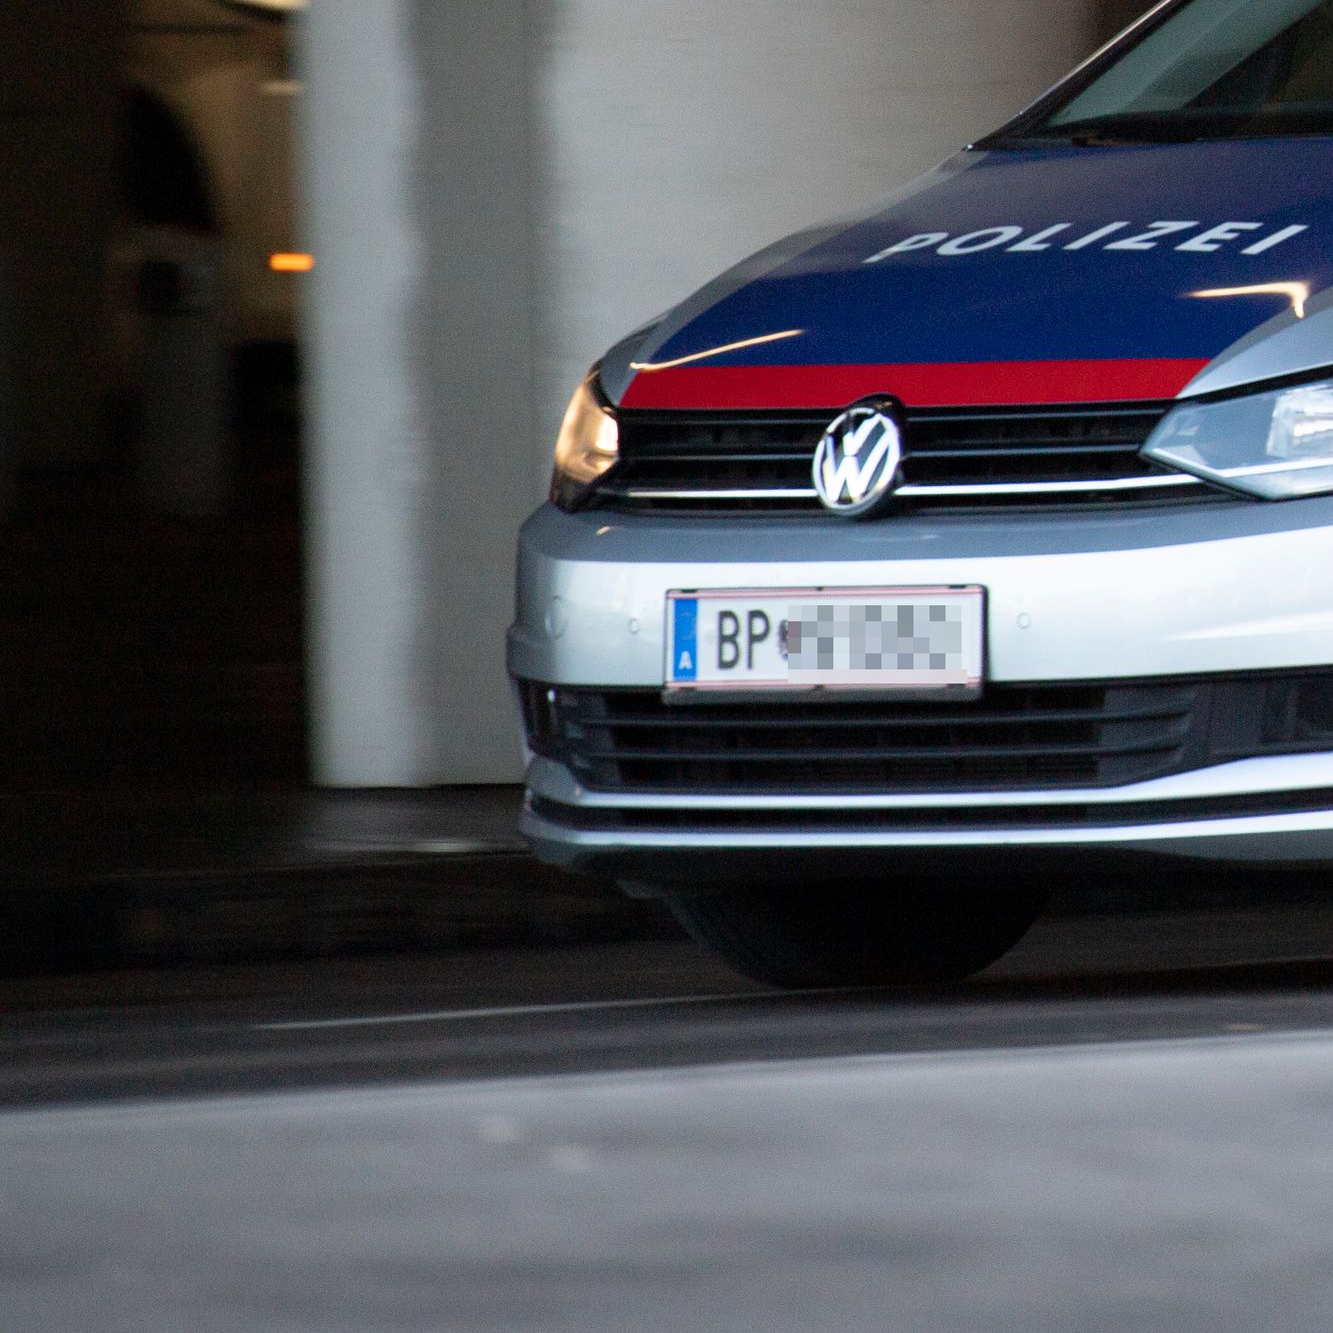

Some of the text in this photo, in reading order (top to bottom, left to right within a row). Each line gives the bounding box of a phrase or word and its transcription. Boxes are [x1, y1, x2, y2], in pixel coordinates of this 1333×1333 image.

[863, 219, 1308, 263] POLIZEI
[678, 651, 693, 670] A
[716, 609, 771, 670] BP
